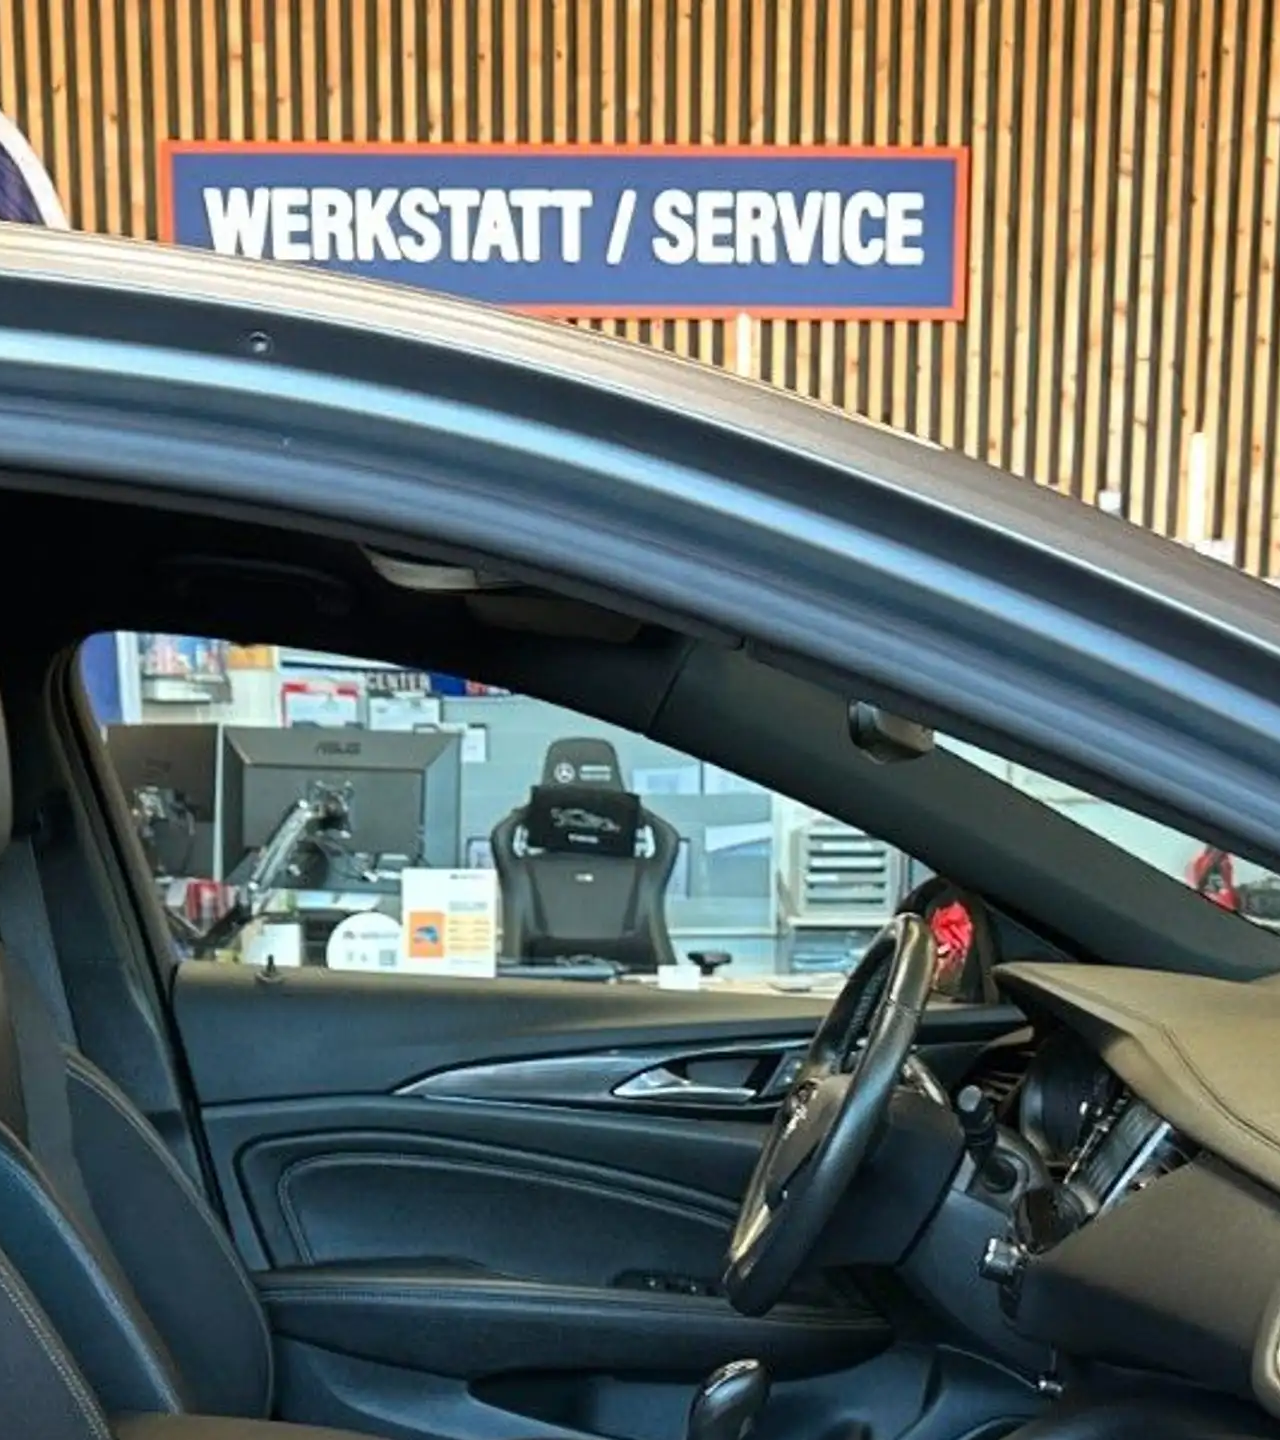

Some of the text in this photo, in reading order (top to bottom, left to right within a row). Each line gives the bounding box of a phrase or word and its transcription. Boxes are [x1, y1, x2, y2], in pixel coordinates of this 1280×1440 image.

[202, 187, 926, 266] WERKSTATT / SERVICE
